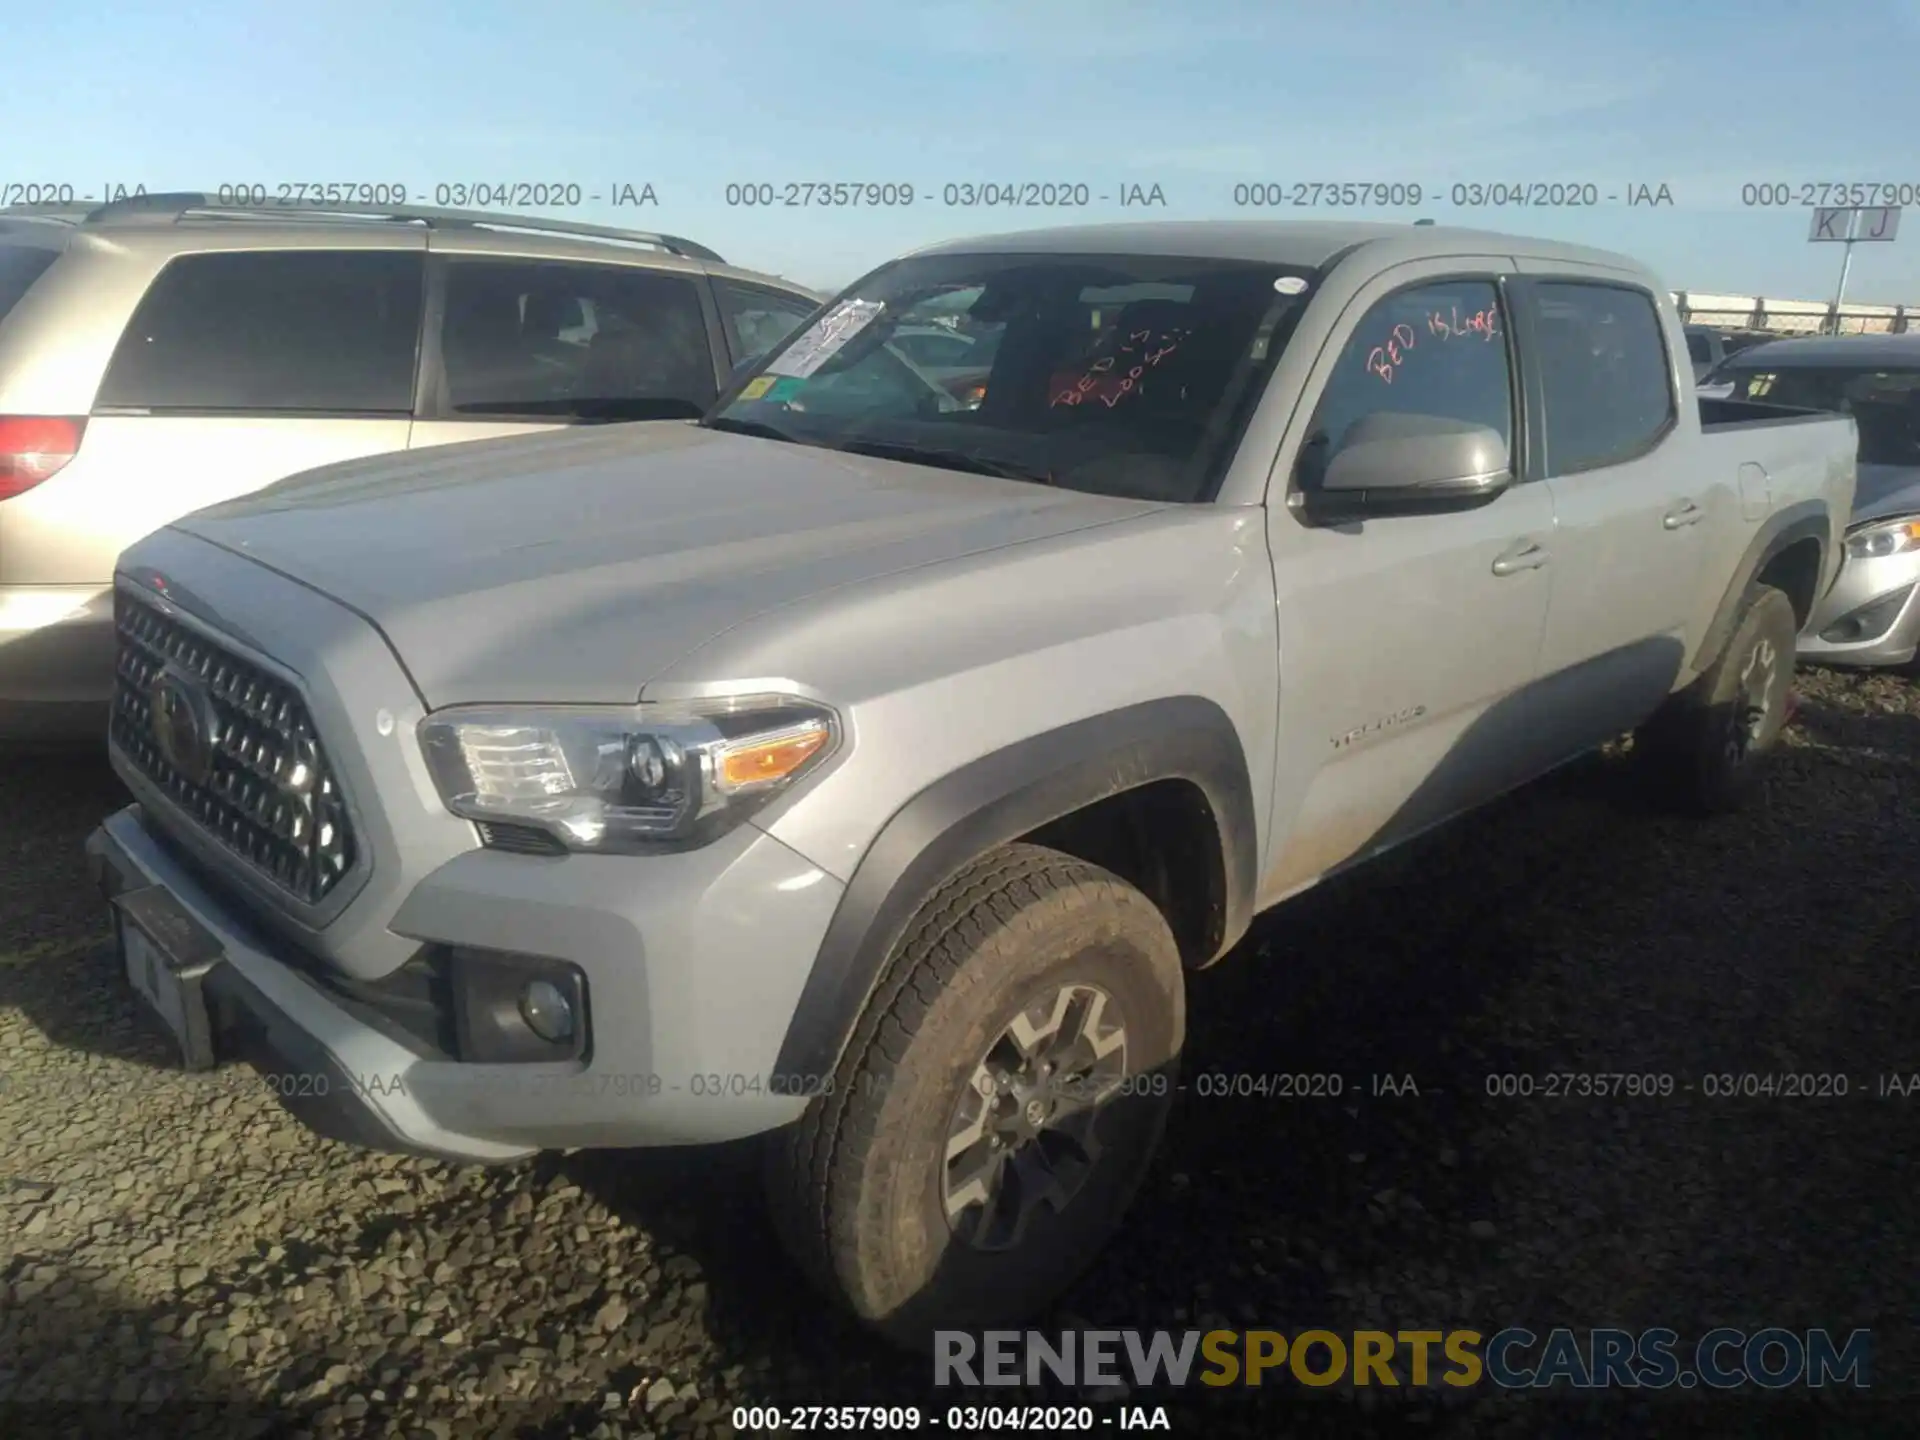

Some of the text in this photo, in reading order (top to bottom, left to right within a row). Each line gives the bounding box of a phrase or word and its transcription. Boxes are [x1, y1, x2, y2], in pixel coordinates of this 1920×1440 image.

[1816, 210, 1840, 238] K
[1869, 207, 1889, 238] J
[1366, 323, 1415, 385] BED
[1050, 356, 1115, 408] BED
